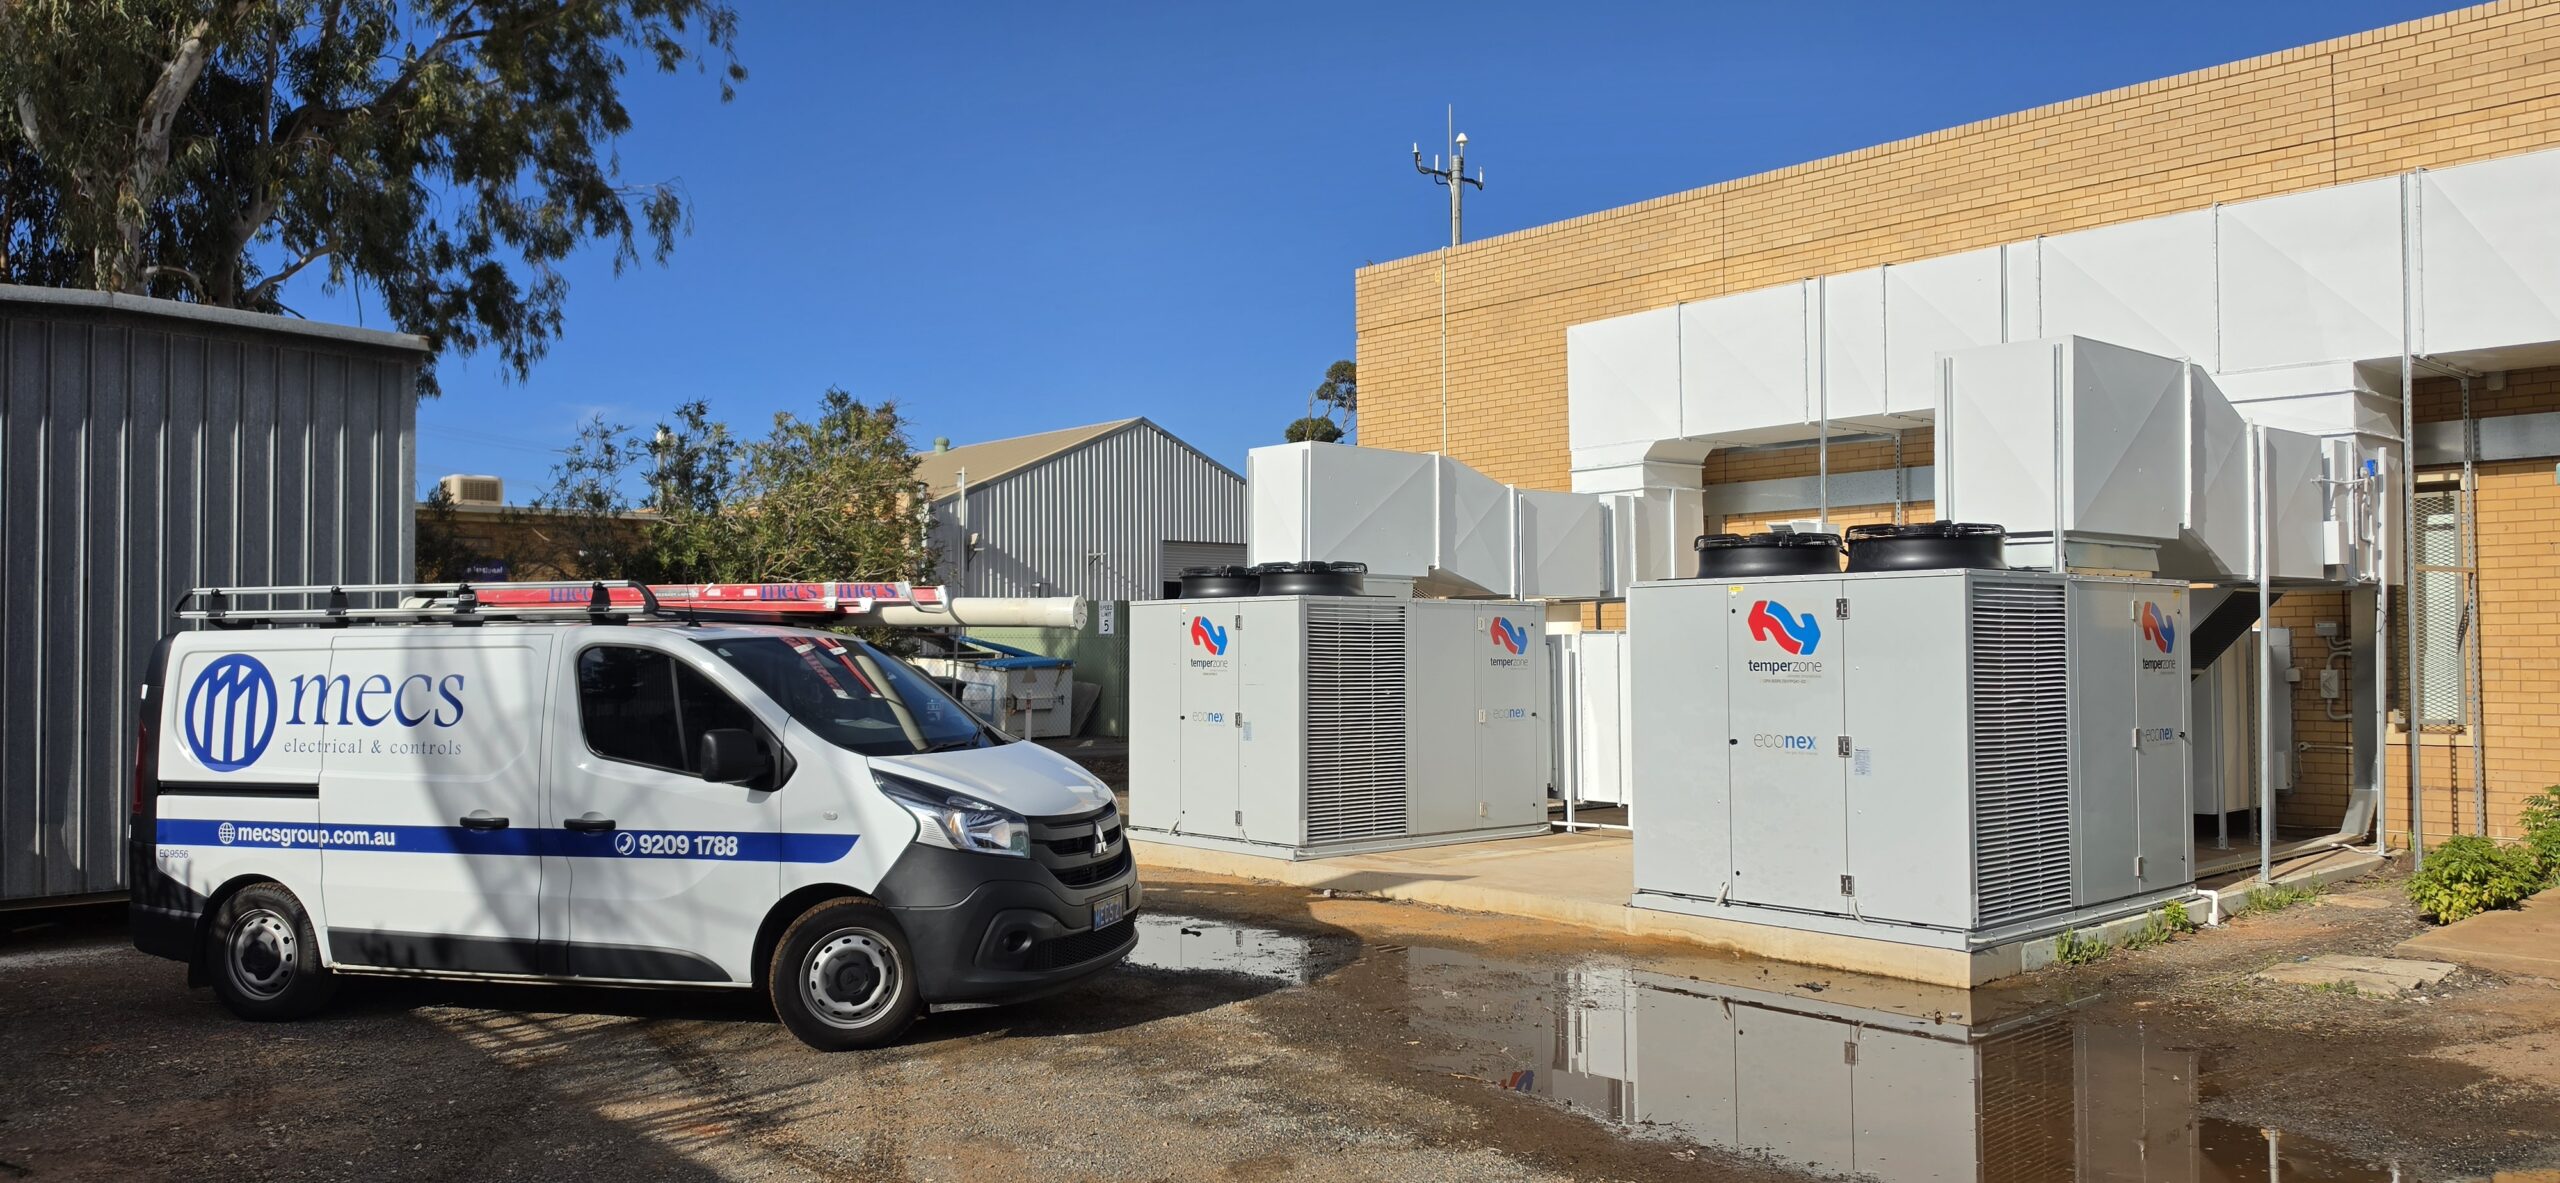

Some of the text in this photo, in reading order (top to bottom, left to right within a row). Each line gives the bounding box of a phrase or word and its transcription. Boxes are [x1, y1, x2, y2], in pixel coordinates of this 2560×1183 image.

[550, 587, 593, 602] mec
[761, 584, 817, 601] mecs
[838, 584, 898, 599] mecs
[1104, 620, 1110, 632] 5
[1190, 658, 1228, 669] temperzone
[1490, 657, 1529, 668] temperzone
[1748, 659, 1822, 675] temperzone
[2142, 658, 2176, 672] temperzone
[286, 674, 465, 728] mecs
[1192, 711, 1225, 723] econex
[1493, 707, 1526, 719] econex
[1753, 733, 1817, 750] econex
[2145, 727, 2174, 742] econex
[284, 738, 462, 755] electrical & controls
[238, 826, 396, 848] mecsgroup.com.au
[639, 834, 738, 857] 9209 1788
[159, 849, 189, 858] EC9556
